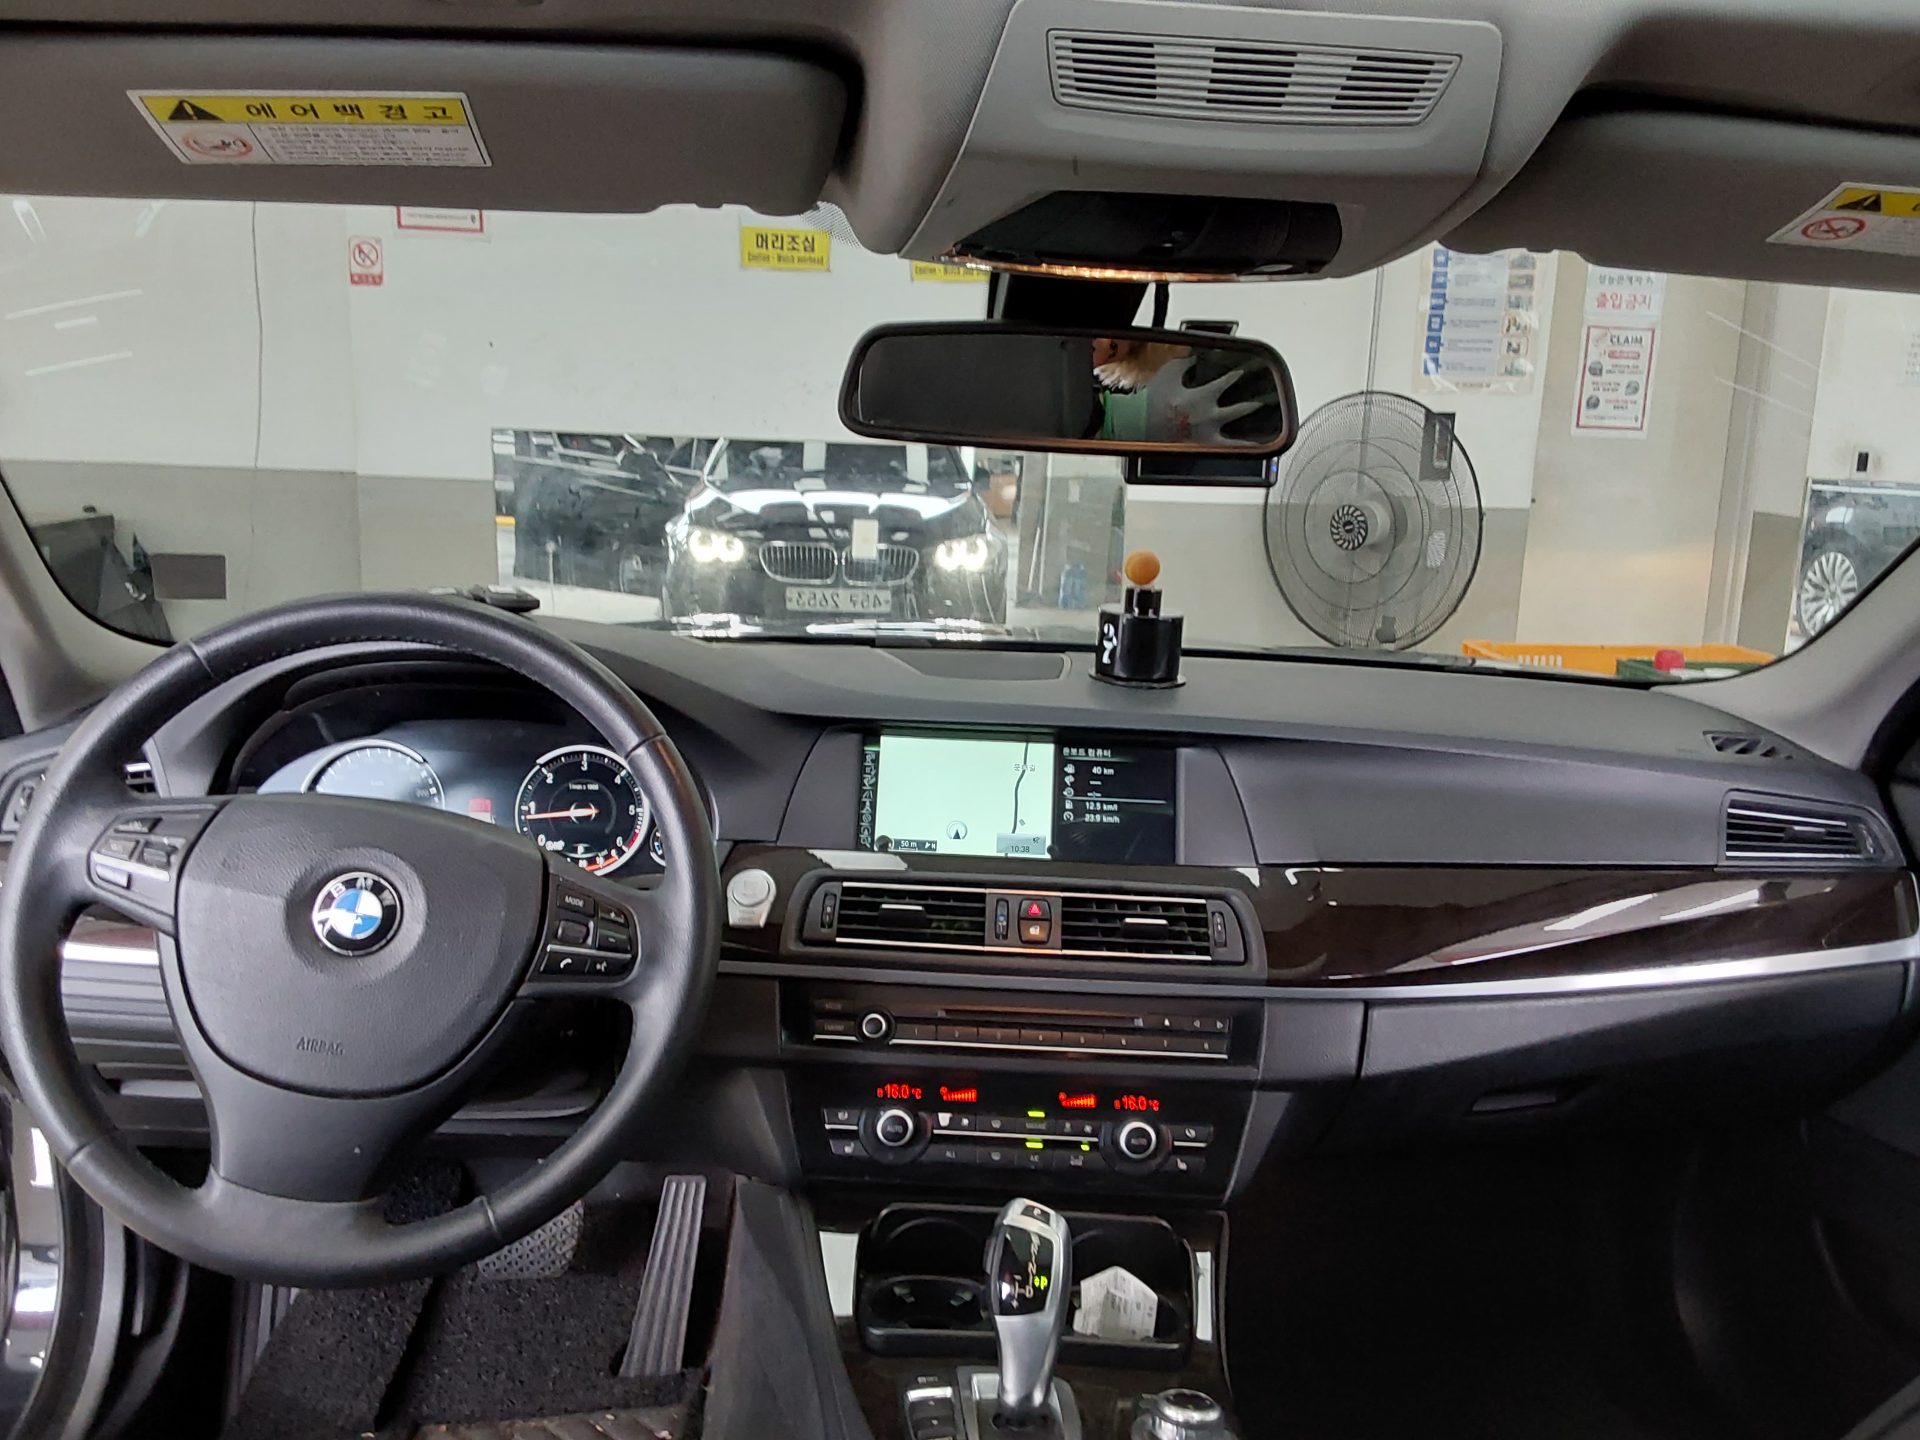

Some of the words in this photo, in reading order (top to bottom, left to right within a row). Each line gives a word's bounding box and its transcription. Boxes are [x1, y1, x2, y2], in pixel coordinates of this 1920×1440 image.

[755, 232, 816, 253] 머리조심
[1609, 335, 1643, 345] CLAIM
[580, 760, 588, 772] 3
[1091, 766, 1102, 775] 40
[1103, 766, 1115, 776] km
[546, 773, 554, 784] 2
[1102, 814, 1120, 824] km/h
[900, 840, 909, 848] 50
[1010, 845, 1030, 853] 10:38
[564, 895, 584, 908] MODE
[296, 1036, 345, 1056] AIRBAG
[884, 1083, 910, 1099] 16.0
[1121, 1094, 1147, 1111] 16.0
